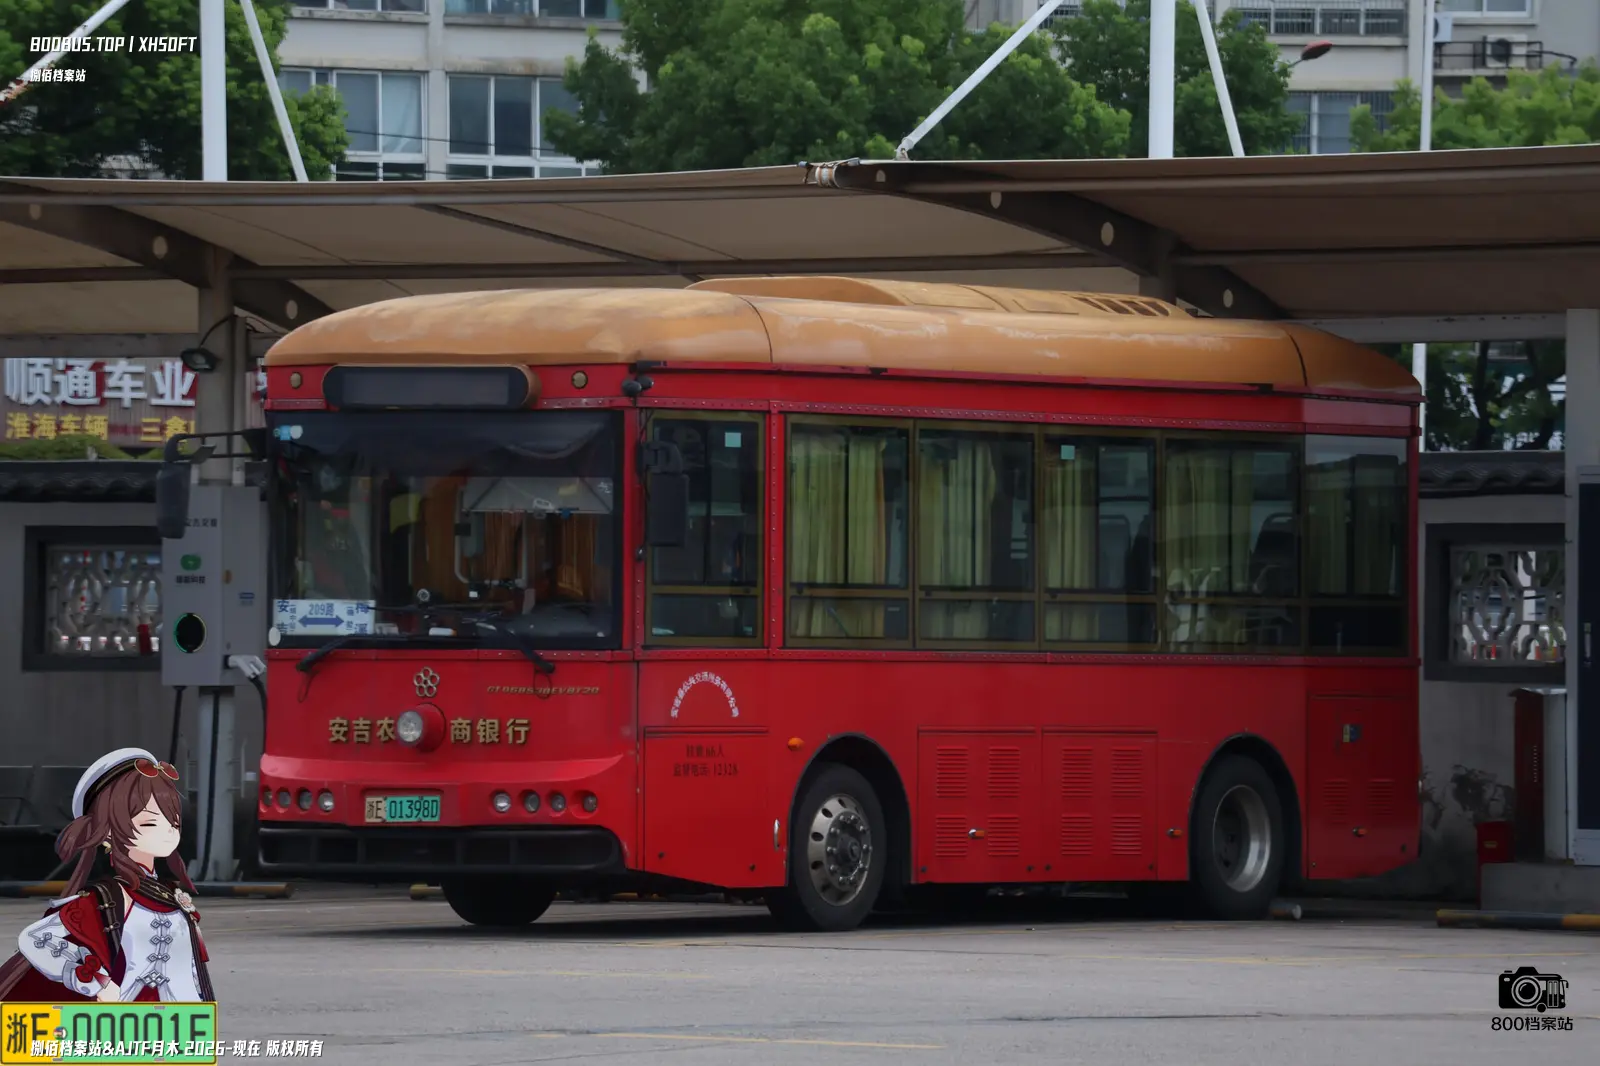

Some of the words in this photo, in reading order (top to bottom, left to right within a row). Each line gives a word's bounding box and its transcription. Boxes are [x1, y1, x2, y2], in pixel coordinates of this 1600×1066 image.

[3, 357, 197, 408] 顺通车业
[5, 411, 109, 441] 淮海车辆
[139, 415, 196, 442] 三鑫
[308, 602, 335, 616] 209路
